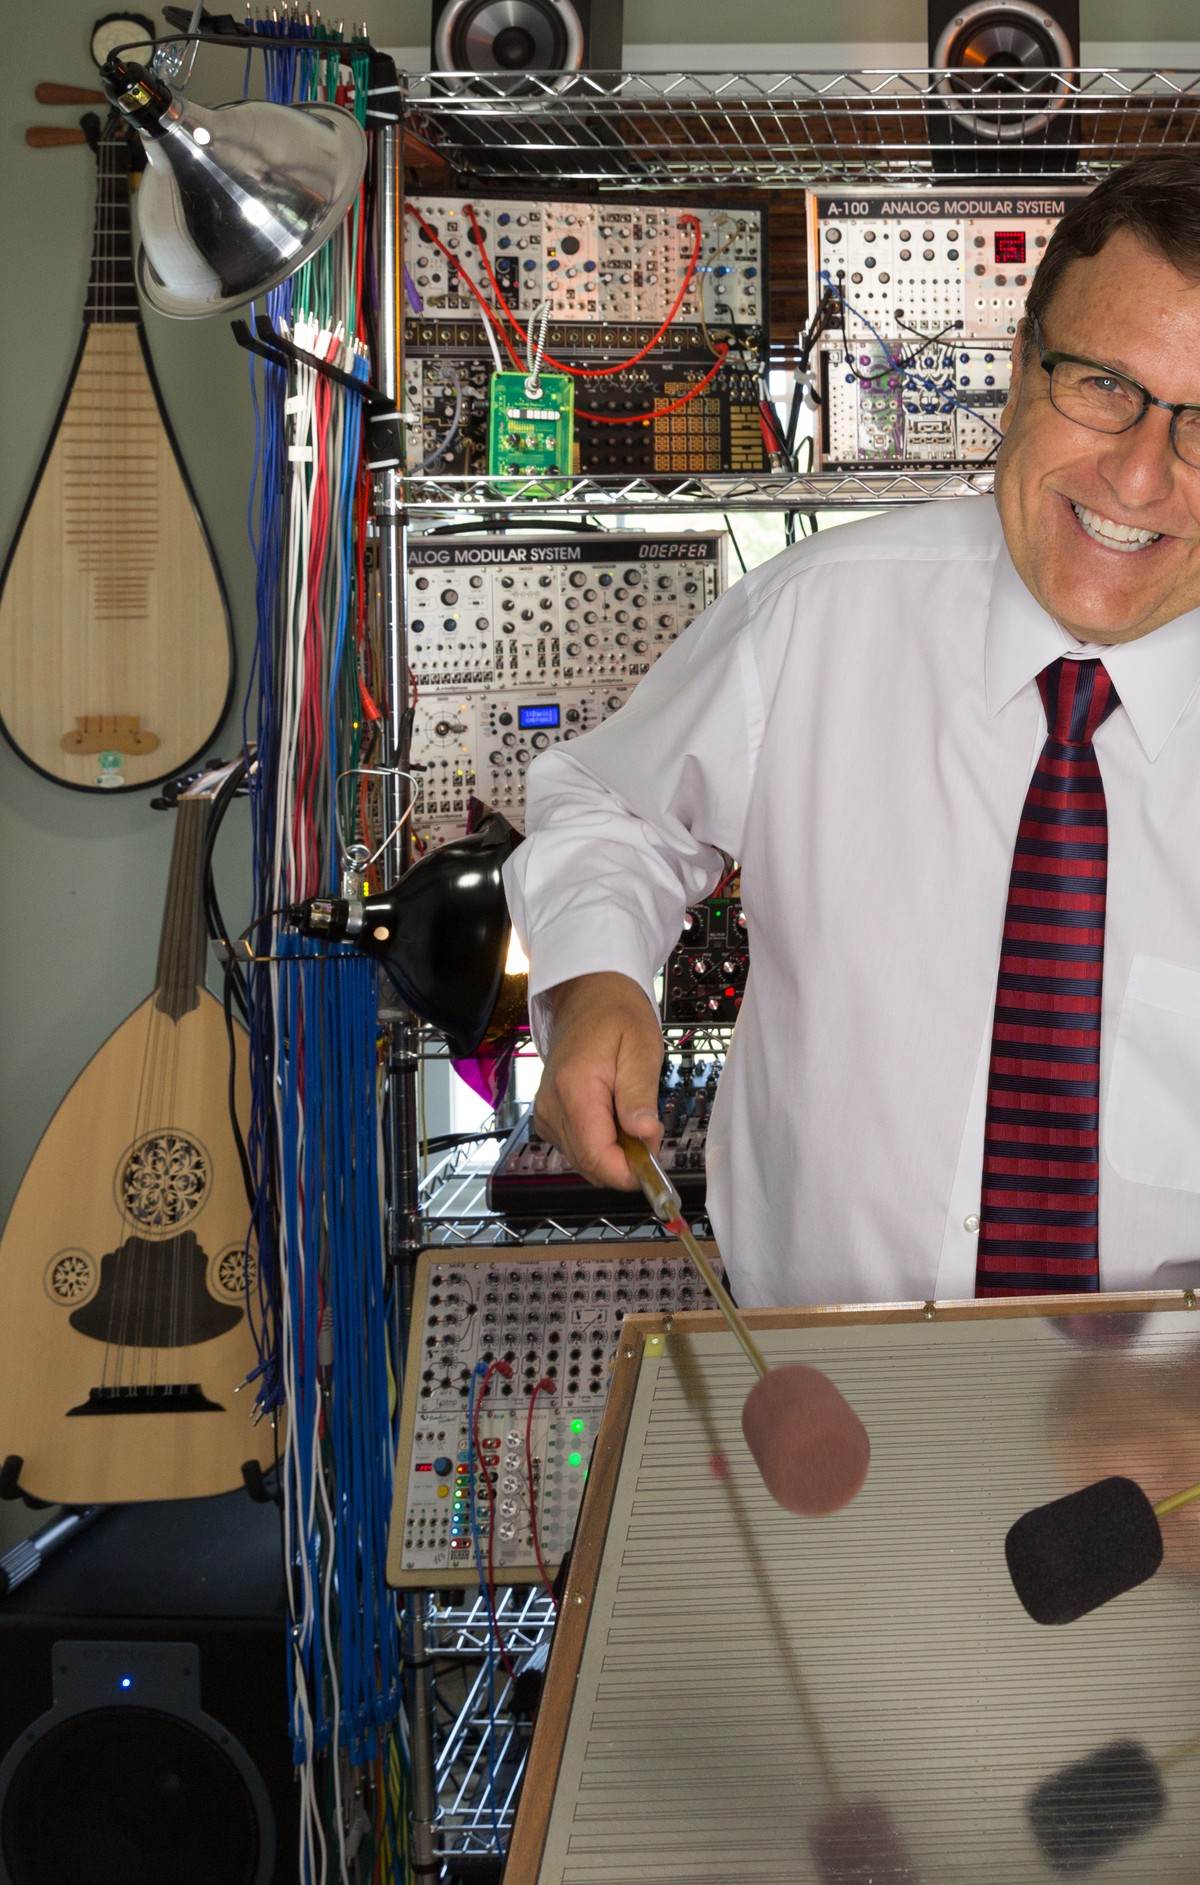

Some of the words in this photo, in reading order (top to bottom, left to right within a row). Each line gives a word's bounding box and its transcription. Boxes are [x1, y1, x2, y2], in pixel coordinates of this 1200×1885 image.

[827, 202, 869, 216] A-100
[880, 201, 940, 215] ANALOG
[944, 201, 1012, 215] MODULAR
[1016, 201, 1065, 214] SYSTEM
[408, 550, 451, 565] ALOG
[454, 548, 527, 563] MODULAR
[530, 547, 581, 561] SYSTEM
[638, 544, 708, 558] DOEPFER
